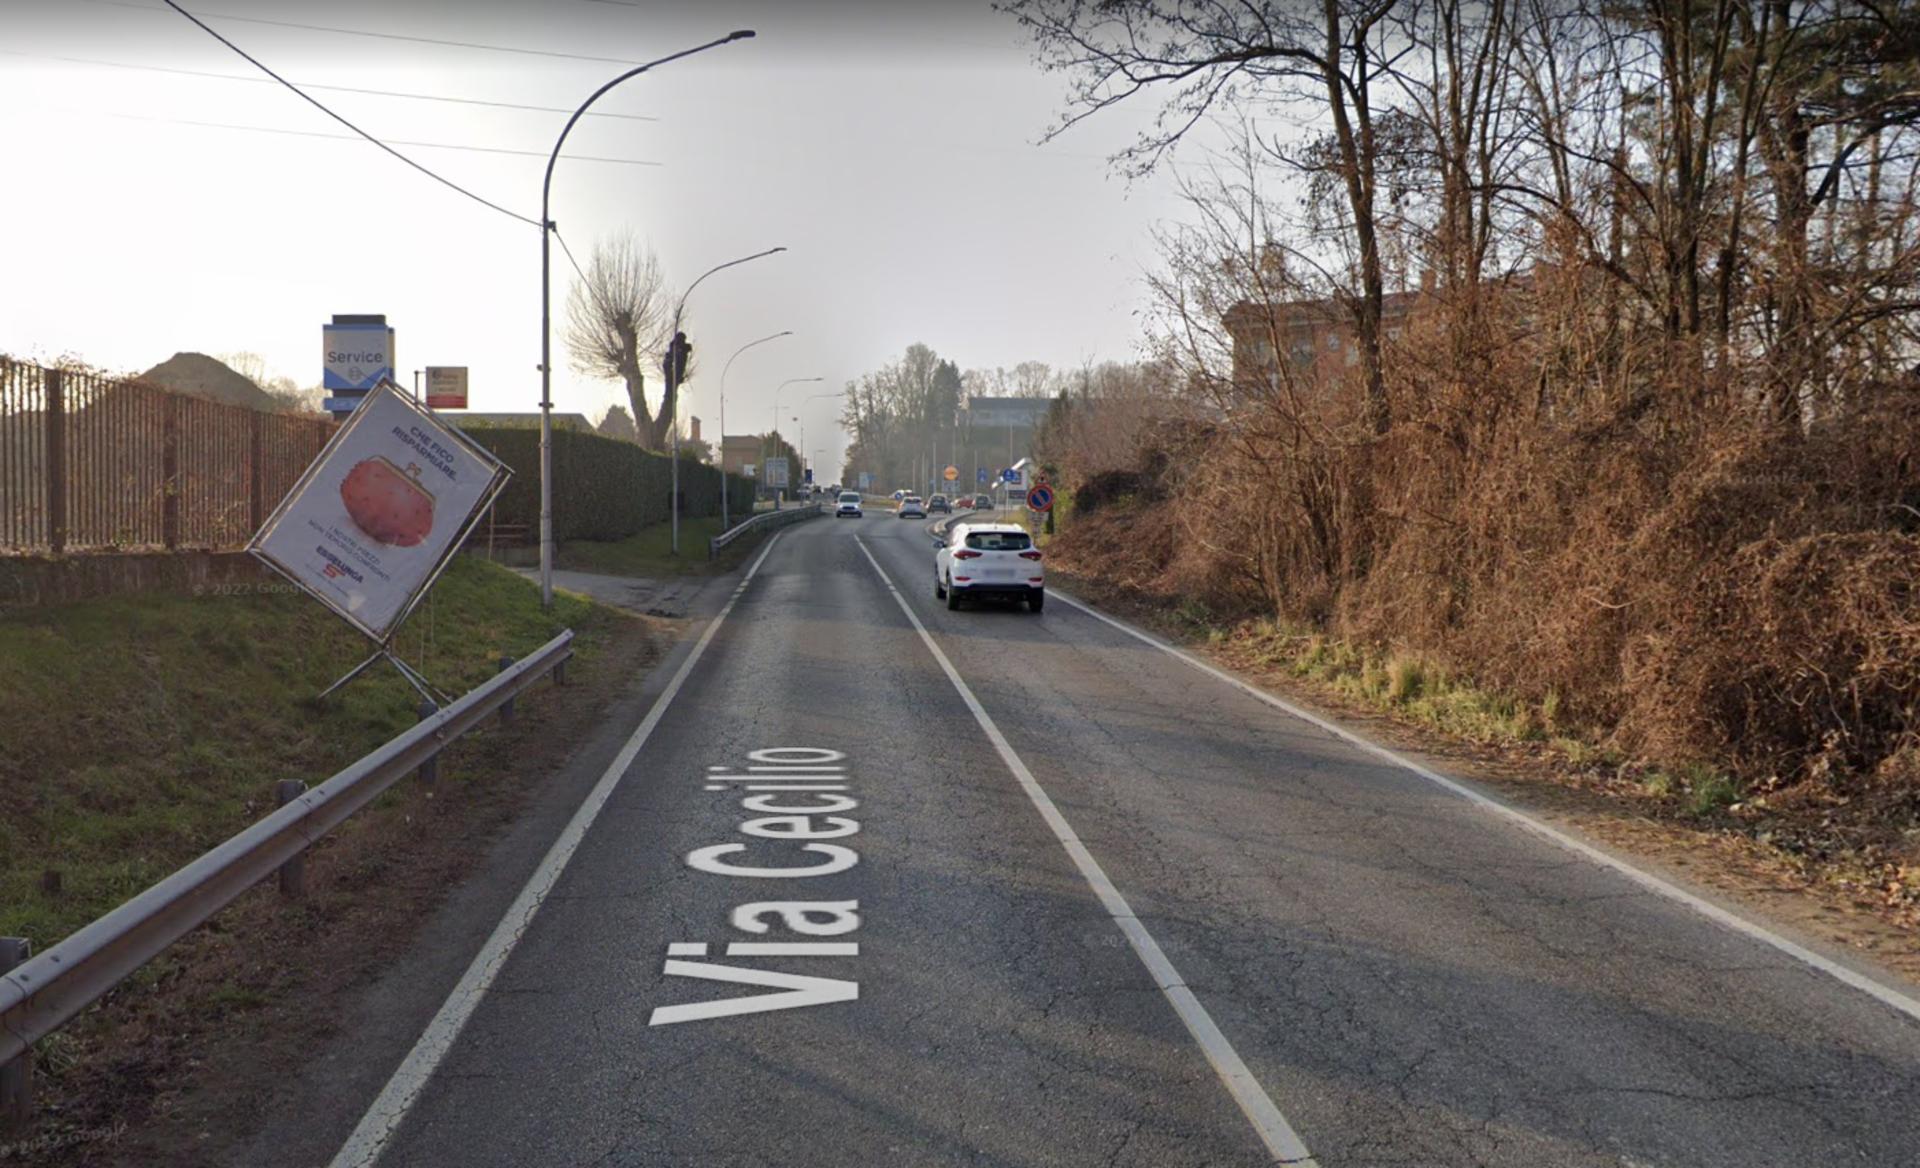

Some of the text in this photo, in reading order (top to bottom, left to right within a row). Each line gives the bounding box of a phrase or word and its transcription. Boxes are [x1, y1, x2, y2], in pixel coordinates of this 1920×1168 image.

[327, 351, 383, 363] Service
[392, 426, 457, 481] RISPARMIARE.
[410, 426, 454, 463] CHE FICO
